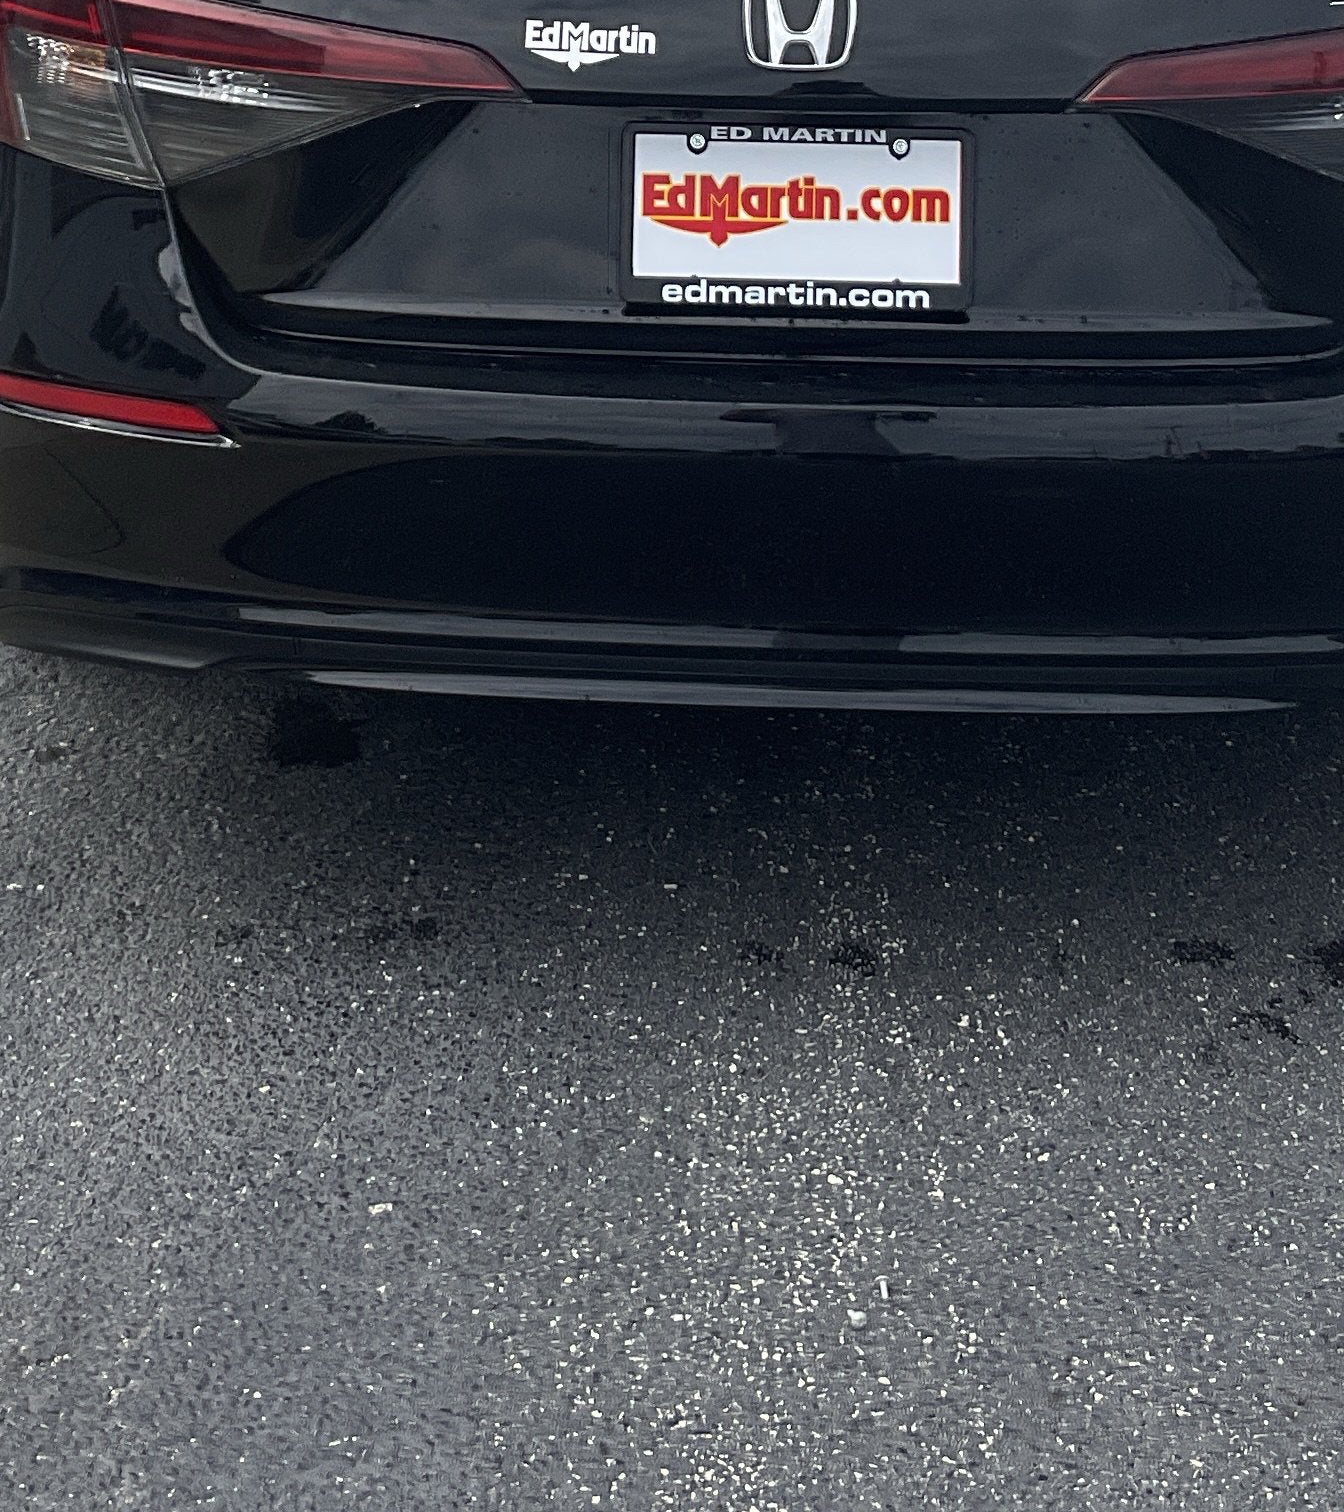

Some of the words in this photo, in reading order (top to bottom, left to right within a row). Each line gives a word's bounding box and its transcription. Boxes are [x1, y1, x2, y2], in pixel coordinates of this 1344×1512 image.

[524, 18, 657, 57] EdMartin
[710, 125, 752, 141] ED
[761, 125, 887, 144] MARTIN
[641, 172, 951, 226] EdMartin.com
[661, 278, 931, 309] edmartin.com
